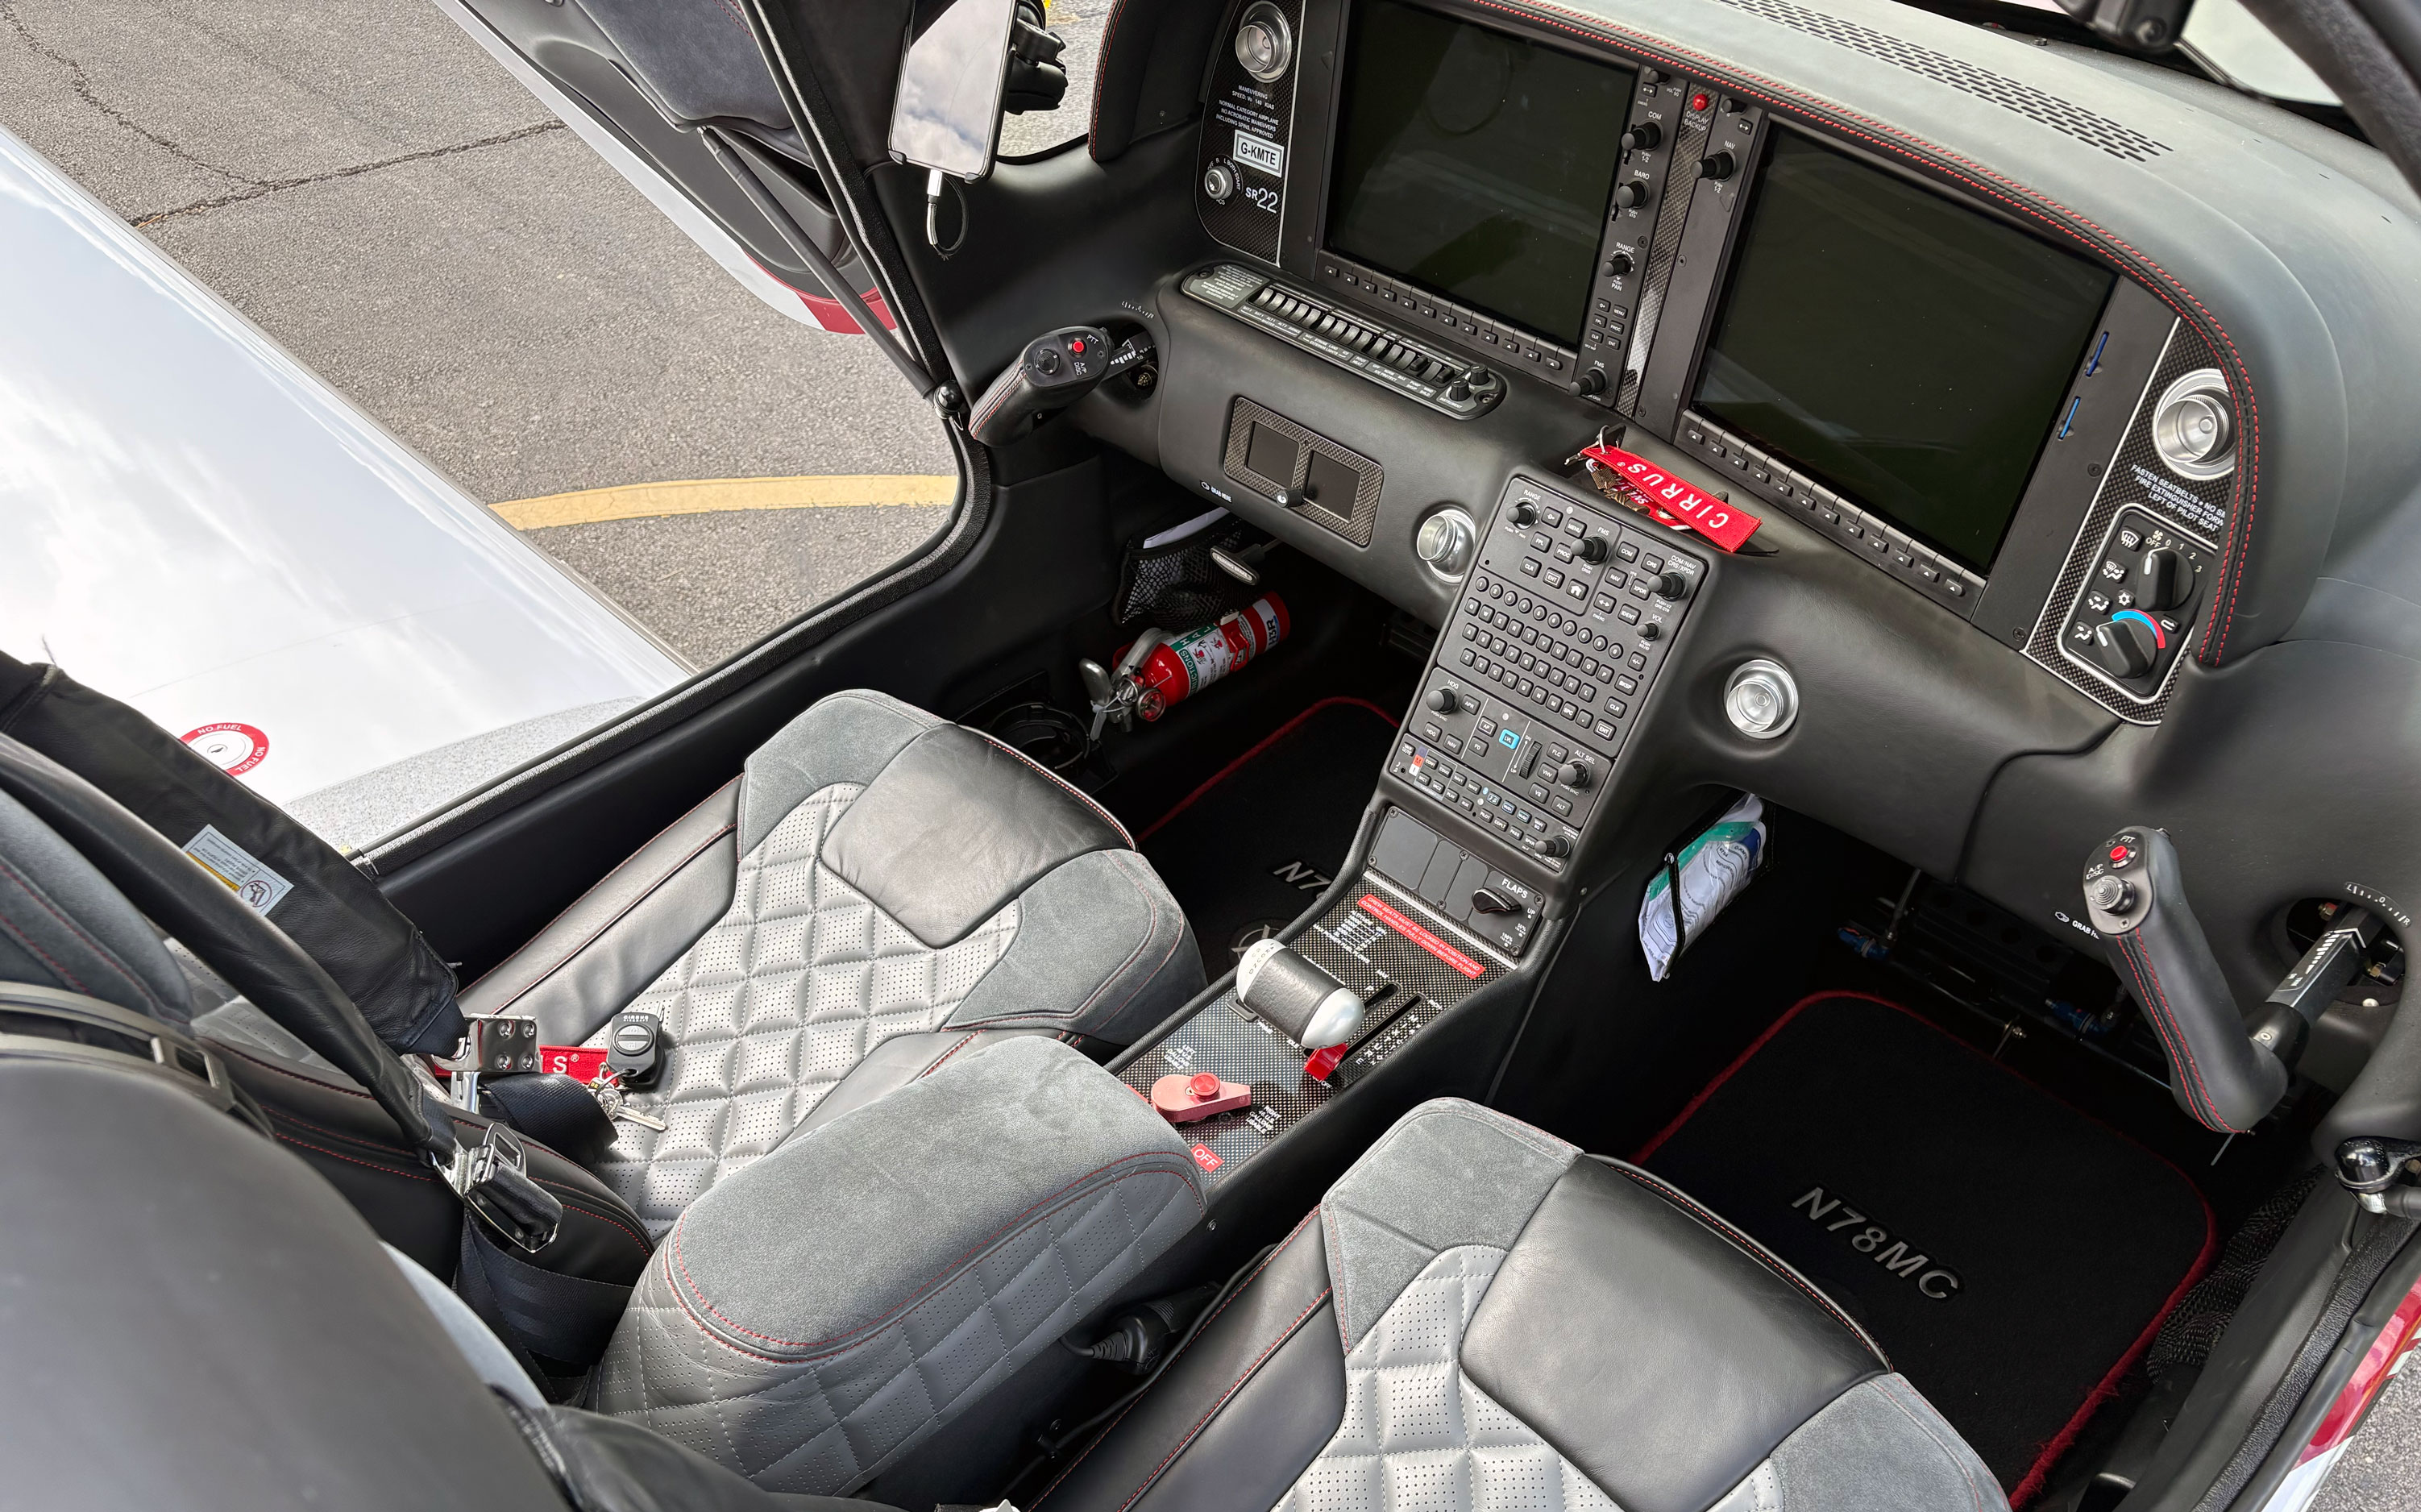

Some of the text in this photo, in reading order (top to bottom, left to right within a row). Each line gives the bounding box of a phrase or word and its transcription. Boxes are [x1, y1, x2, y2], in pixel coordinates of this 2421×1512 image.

[1238, 85, 1268, 99] MANEUVERING
[1219, 100, 1279, 126] NORMAL CATEGORY AIRPLANE
[1648, 111, 1662, 120] COM
[1686, 111, 1709, 124] DISPLAY
[1215, 114, 1238, 126] INCLUDING
[1251, 127, 1273, 139] APPROVED
[1228, 110, 1251, 123] ACROBATIC
[1251, 118, 1277, 132] MANEUVERS
[1684, 118, 1707, 132] BACKUP
[1724, 140, 1736, 150] NAV
[1241, 142, 1277, 166] G-KMTE
[1227, 160, 1236, 173] BOTH
[1634, 169, 1650, 180] BARO
[1616, 242, 1634, 253] RANGE
[1611, 282, 1622, 291] PAN
[1611, 324, 1621, 332] PROC
[1086, 334, 1099, 344] PTT
[1074, 361, 1082, 376] DISC
[1594, 360, 1605, 369] FMS
[1380, 371, 1397, 382] PROTECT
[2130, 464, 2158, 482] FASTEN
[2158, 477, 2199, 503] SEATBELTS
[2203, 502, 2216, 513] NO
[1523, 489, 1541, 501] RANGE
[1628, 463, 1730, 529] CIRRUS
[2135, 476, 2152, 488] FIRE
[2151, 484, 2203, 515] EXTINGUISHER
[2203, 511, 2224, 526] FORW
[2148, 492, 2219, 532] LEFT OF PILOT SEAT
[1568, 523, 1582, 533] MENU
[1598, 527, 1610, 536] FMS
[2145, 537, 2161, 548] OFF
[1557, 548, 1570, 558] PROC
[1621, 548, 1633, 557] COM
[1647, 560, 1657, 569] CRS
[1667, 559, 1694, 577] CRS/XPDR
[1671, 555, 1696, 570] COM/NAV
[1634, 585, 1647, 594] XPDR
[1622, 610, 1636, 621] IDENT
[1652, 614, 1662, 623] VOL
[1447, 679, 1459, 689] HDG
[197, 726, 213, 734] NO
[1426, 728, 1436, 737] HDG
[1599, 727, 1609, 735] ENT
[1447, 740, 1457, 748] NAV
[1552, 749, 1561, 757] FLC
[1574, 750, 1595, 764] ALT SEL
[235, 746, 266, 772] NO FUEL
[1480, 811, 1490, 820] PILOT
[1510, 828, 1520, 837] PASS
[1525, 838, 1535, 846] SPKR
[2088, 864, 2103, 873] A/P
[2086, 869, 2103, 880] DISC
[1502, 879, 1528, 899] FLAPS
[1517, 923, 1526, 931] 50%
[2072, 920, 2091, 934] GRAB
[1360, 900, 1476, 976] CONTROL HANDLES FULLY DOWN BEFORE FLIGHT
[1368, 896, 1382, 908] CREW
[1382, 906, 1399, 919] SEATS
[1397, 916, 1413, 927] MUST
[1418, 930, 1439, 945] LOCKED
[1444, 946, 1469, 964] POSITION
[1466, 961, 1480, 971] AND
[1427, 999, 1443, 1009] RICH
[1287, 1038, 1299, 1049] IDLE
[1356, 1014, 1418, 1065] MIXTURE
[1264, 1105, 1281, 1120] RIGHT
[1246, 1116, 1267, 1134] USABLE
[1249, 1111, 1273, 1130] GALLONS
[1194, 1149, 1219, 1166] OFF
[1792, 1186, 1958, 1299] N78MC
